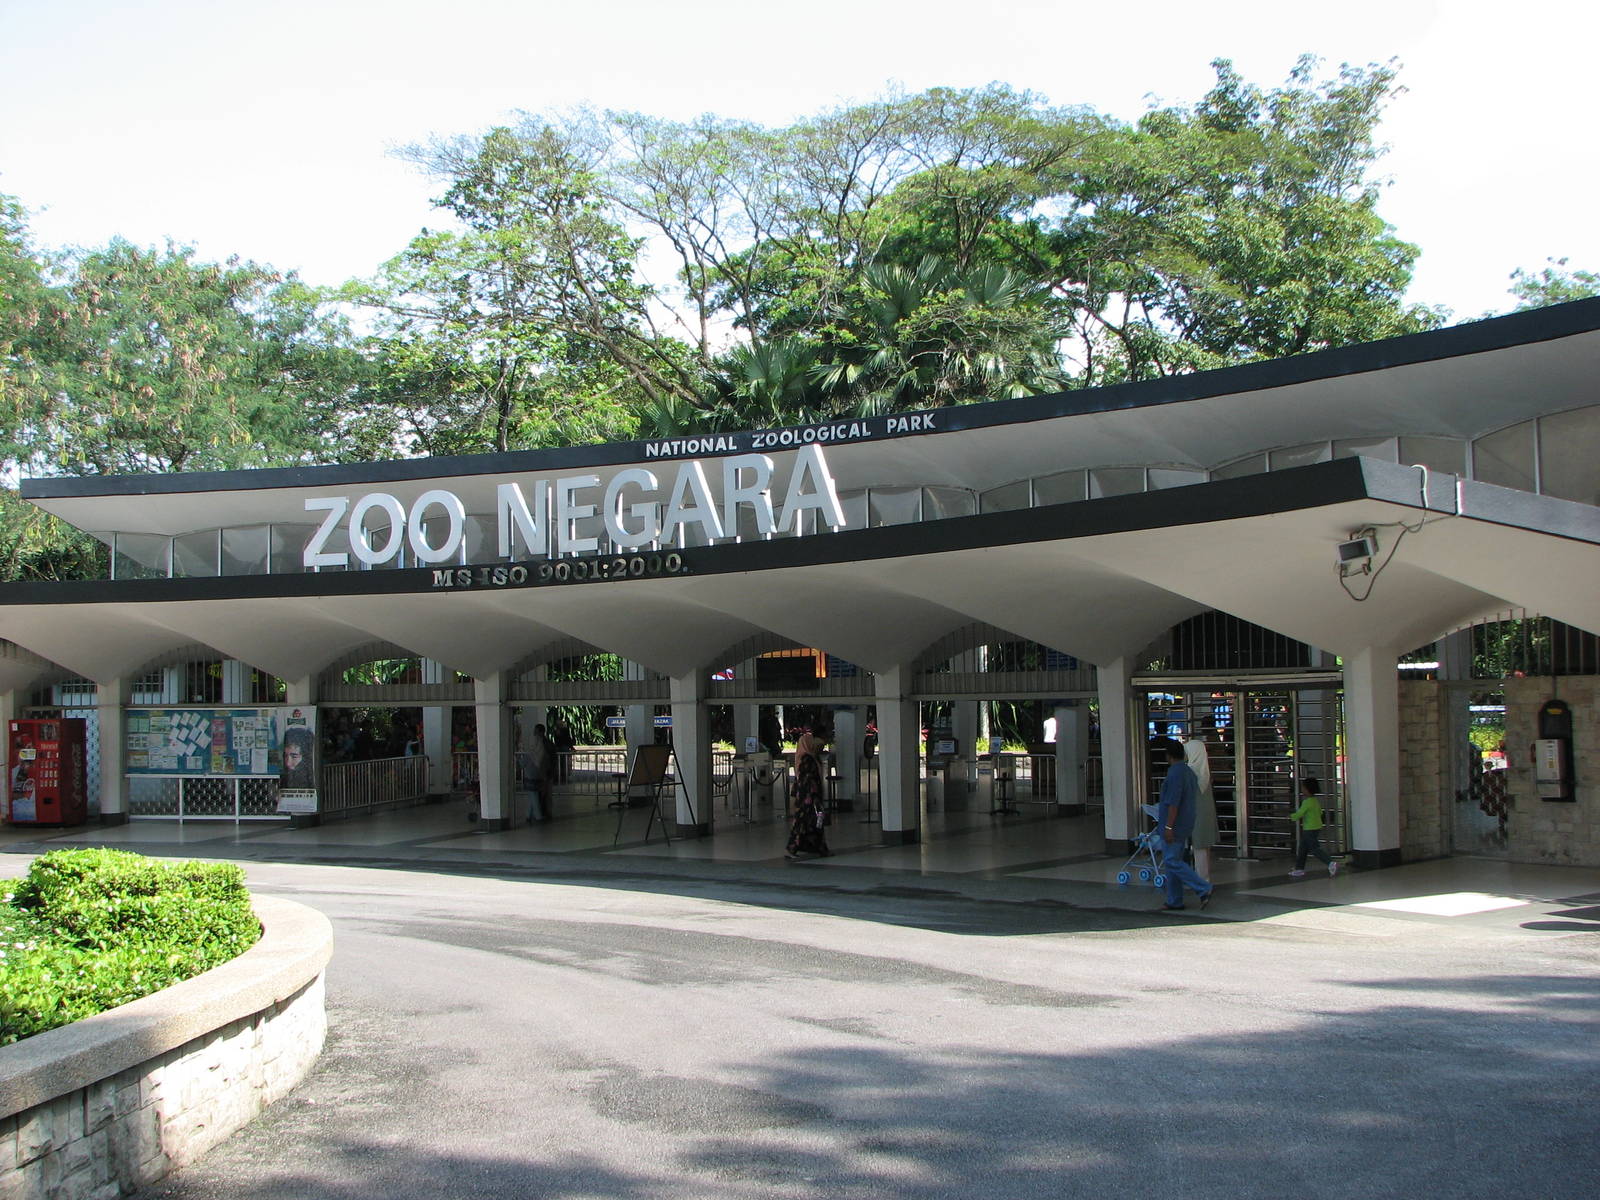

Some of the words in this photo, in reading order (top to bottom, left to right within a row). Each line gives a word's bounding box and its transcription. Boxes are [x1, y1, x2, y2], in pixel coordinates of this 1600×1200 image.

[645, 435, 737, 458] NATIONAL
[751, 421, 871, 448] ZOOLOGICAL
[886, 412, 936, 434] PARK
[303, 489, 466, 568] ZOO
[497, 443, 846, 557] NEGARA
[432, 568, 472, 588] MS
[480, 565, 529, 586] ISO
